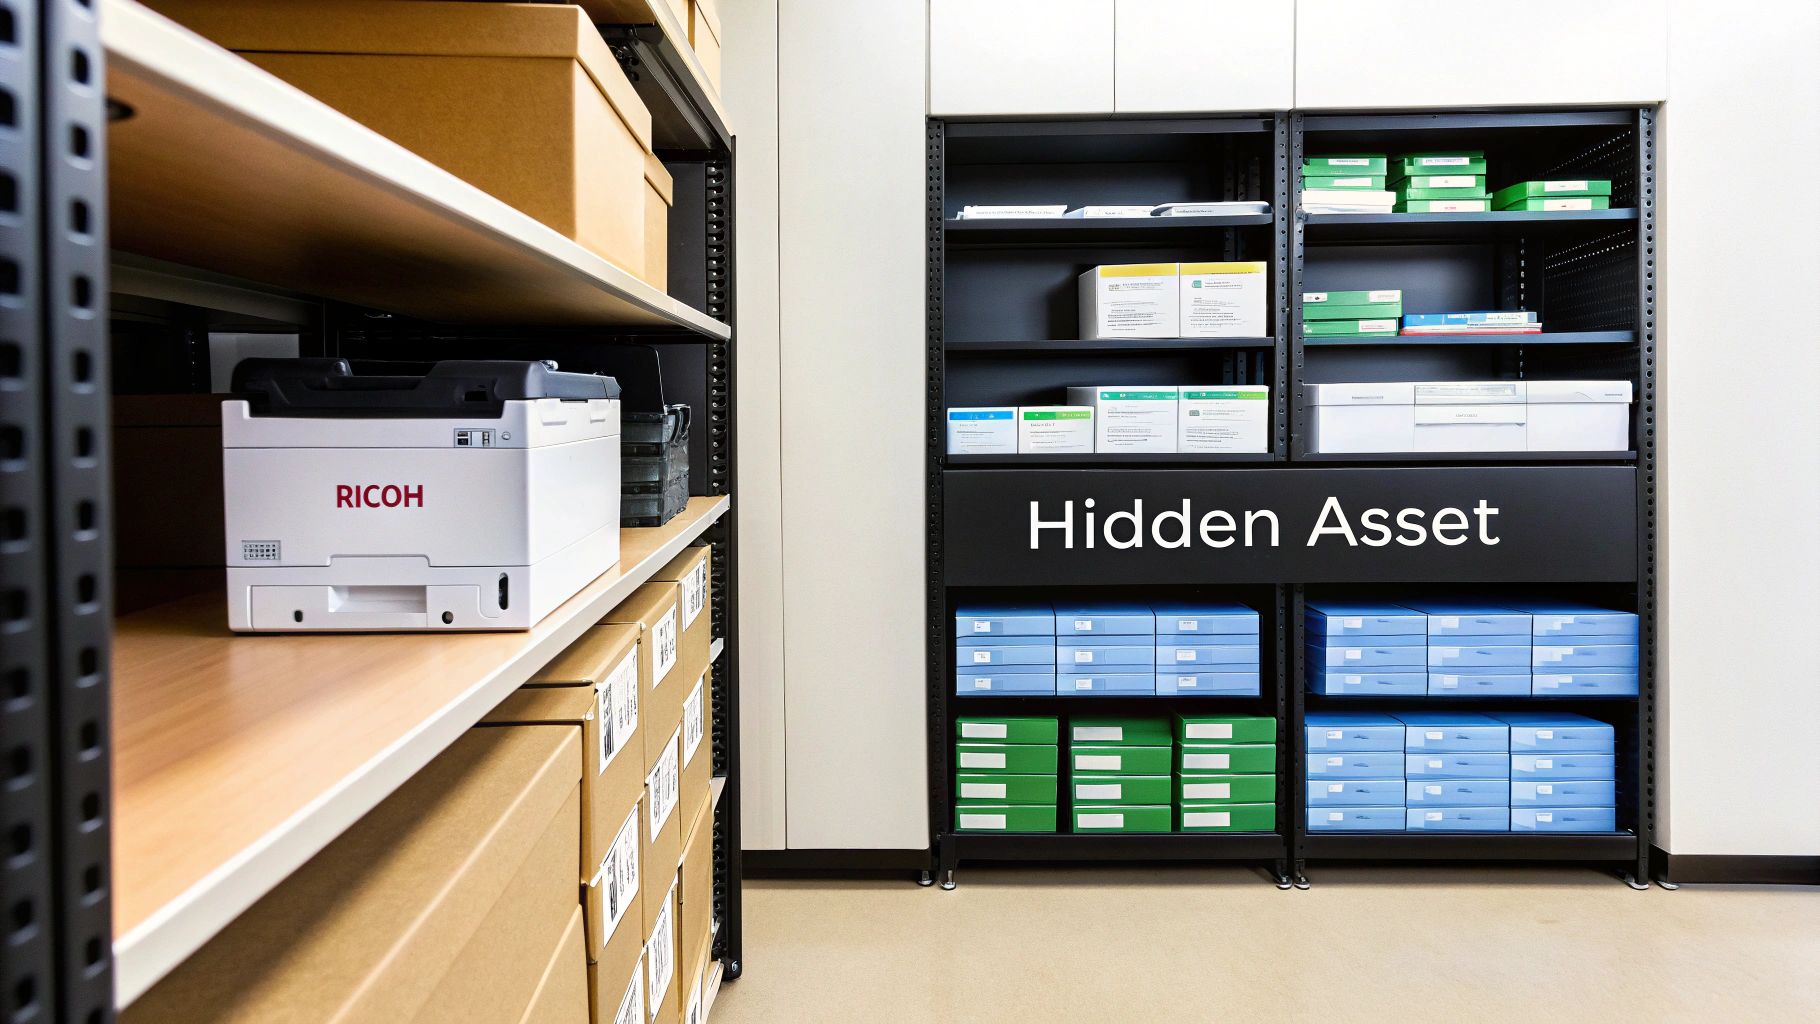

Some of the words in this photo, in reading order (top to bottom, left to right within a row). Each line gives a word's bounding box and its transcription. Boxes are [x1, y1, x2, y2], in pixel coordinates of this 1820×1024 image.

[336, 484, 423, 508] RICOH
[1031, 498, 1279, 549] Hidden
[1307, 497, 1500, 546] Asset
